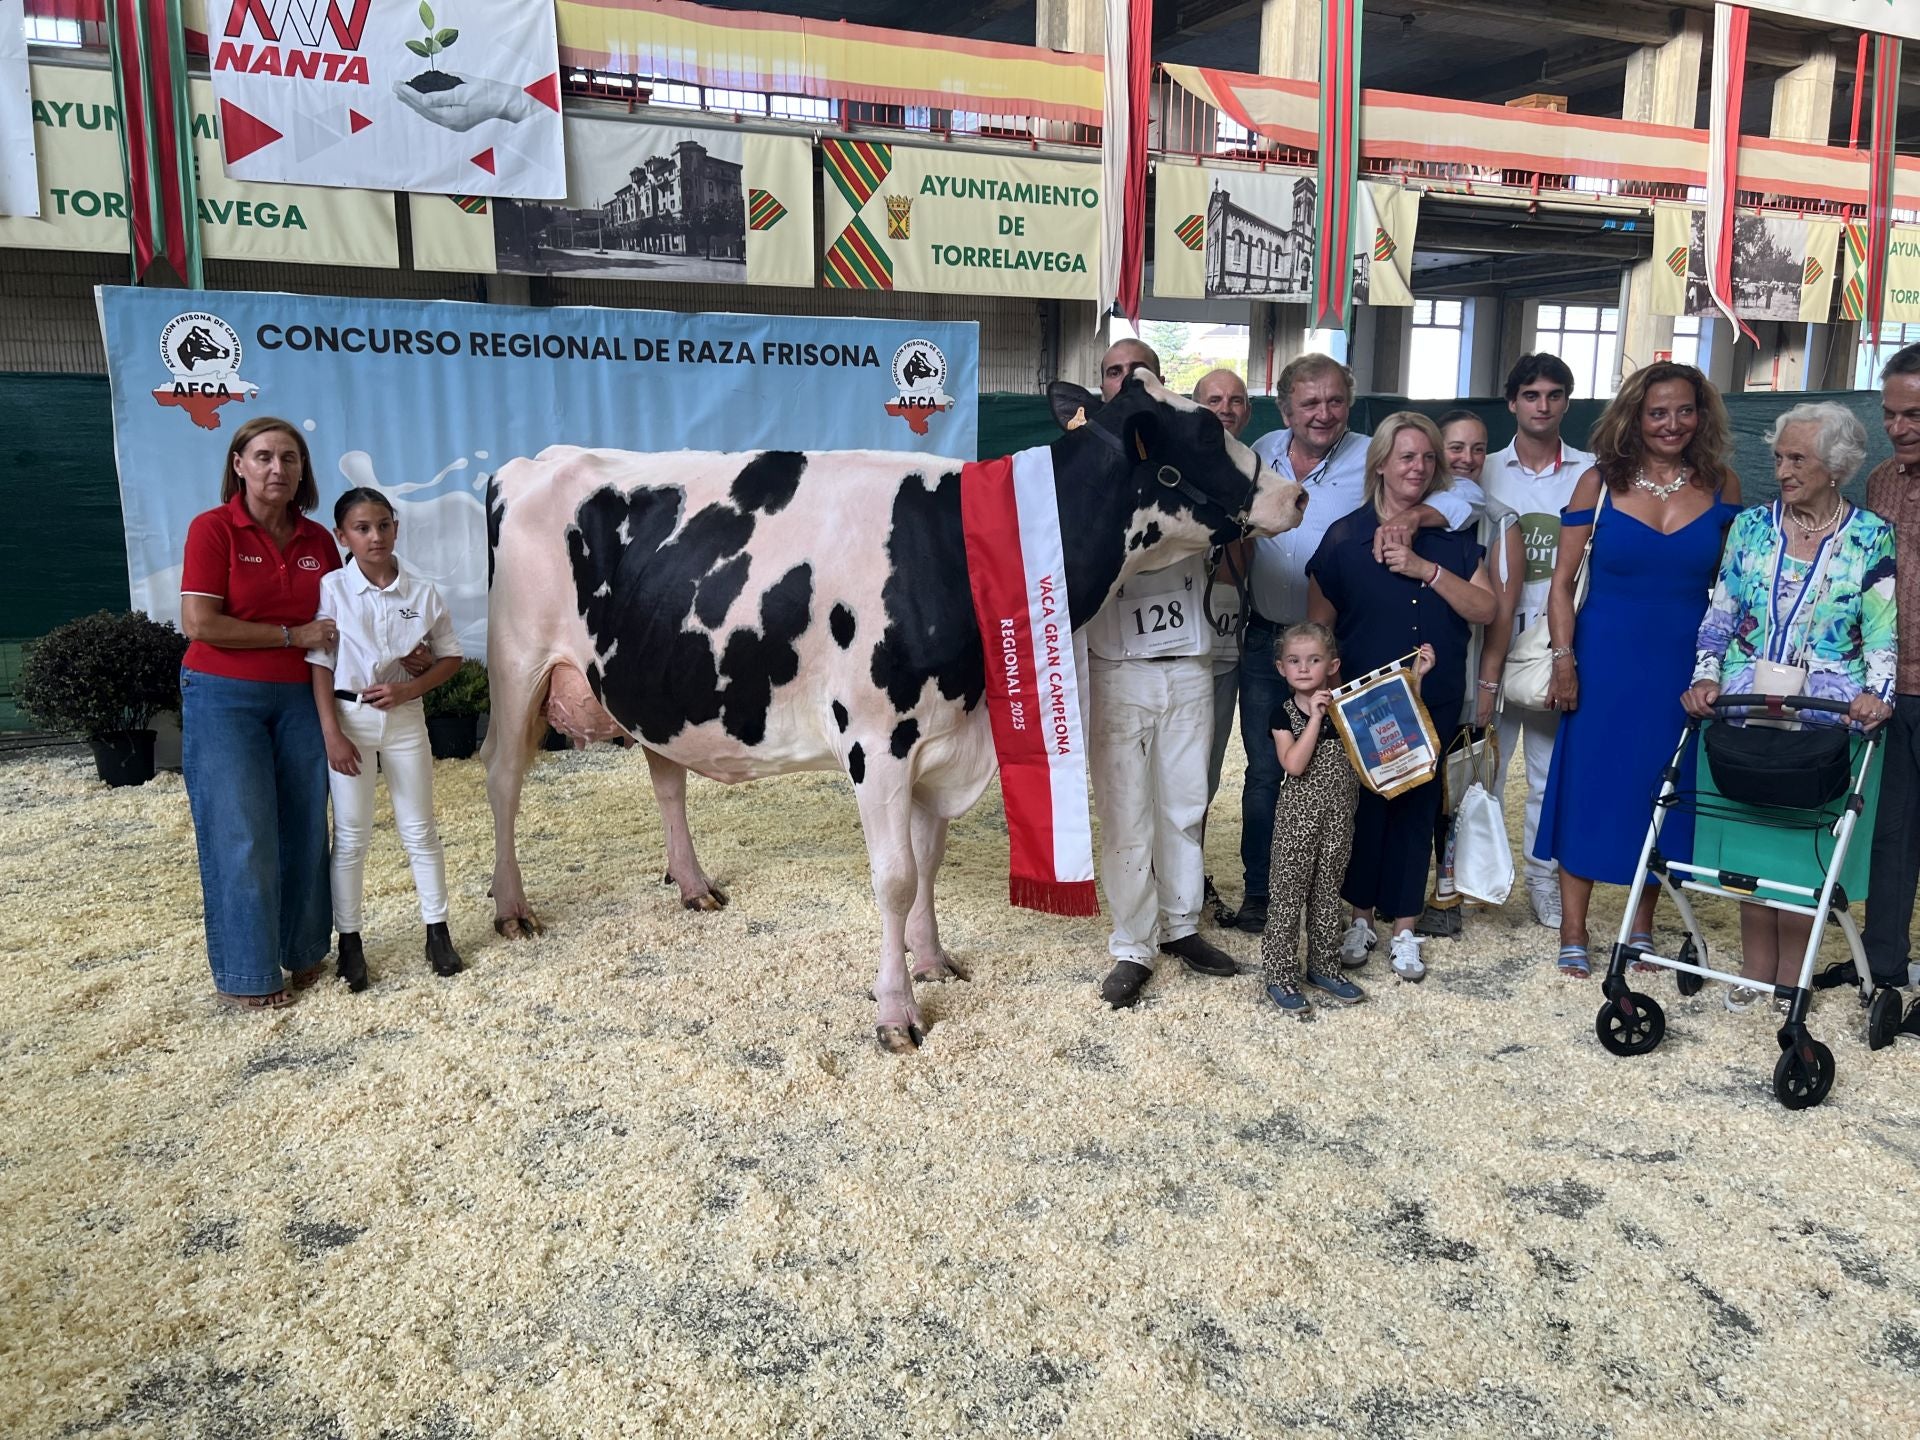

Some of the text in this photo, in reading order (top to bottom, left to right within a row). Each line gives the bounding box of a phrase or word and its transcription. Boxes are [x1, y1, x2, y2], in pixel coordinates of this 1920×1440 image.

[214, 41, 370, 85] NANTA
[920, 175, 1099, 208] AYUNTAMIENTO
[998, 215, 1025, 236] DE
[931, 244, 1087, 273] TORRELAVEGA
[176, 314, 212, 325] FRISONA
[213, 319, 224, 328] DE
[224, 327, 241, 369] CANTABRIA
[256, 324, 881, 368] CONCURSO REGIONAL DE RAZA FRISONA
[172, 381, 231, 399] AFCA
[898, 396, 936, 410] AFCA
[1131, 600, 1185, 636] 128
[1001, 618, 1026, 731] REGIONAL 2025
[1039, 574, 1071, 756] VACA GRAN CAMPEONA
[1375, 720, 1396, 736] Vaca
[1379, 730, 1400, 746] Gran
